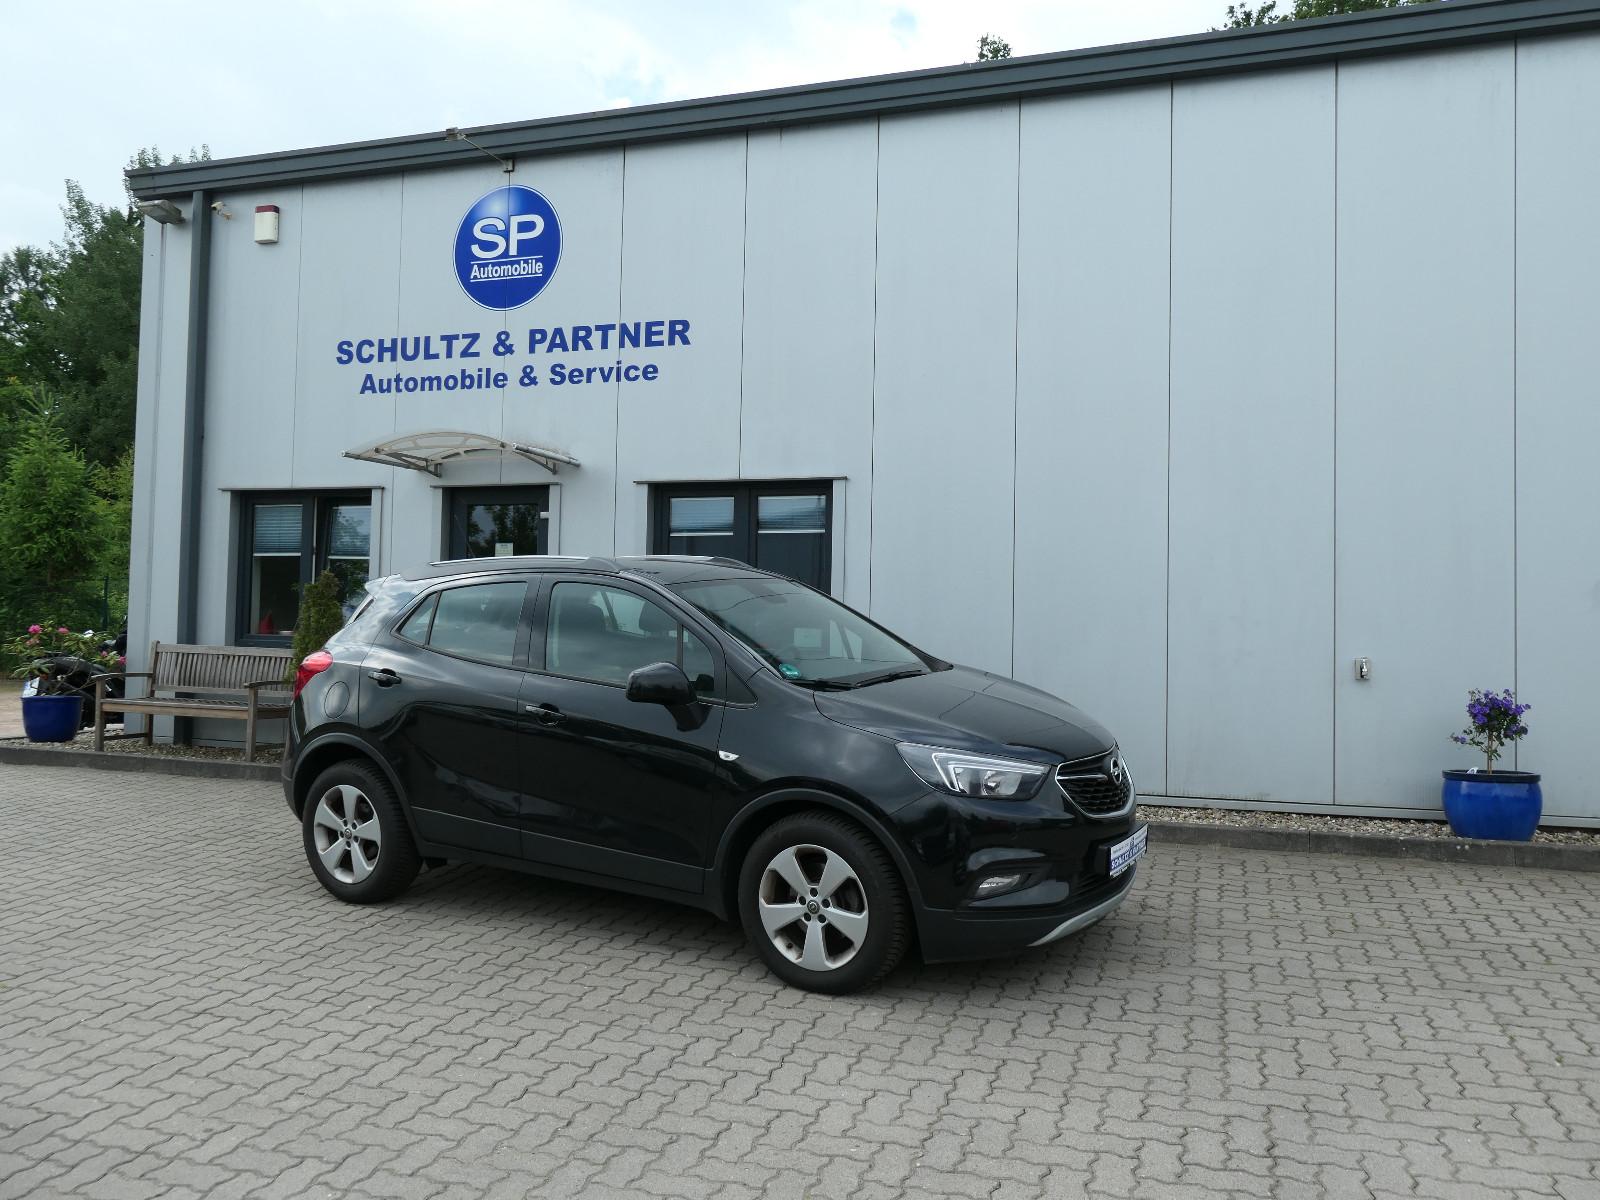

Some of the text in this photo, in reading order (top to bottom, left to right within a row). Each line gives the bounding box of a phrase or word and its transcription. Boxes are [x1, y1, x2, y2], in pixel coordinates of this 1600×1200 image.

[470, 213, 545, 259] SP
[470, 260, 543, 280] Automobile
[336, 319, 691, 365] SCHULTZ & PARTNER
[360, 360, 659, 394] Automobile & Service
